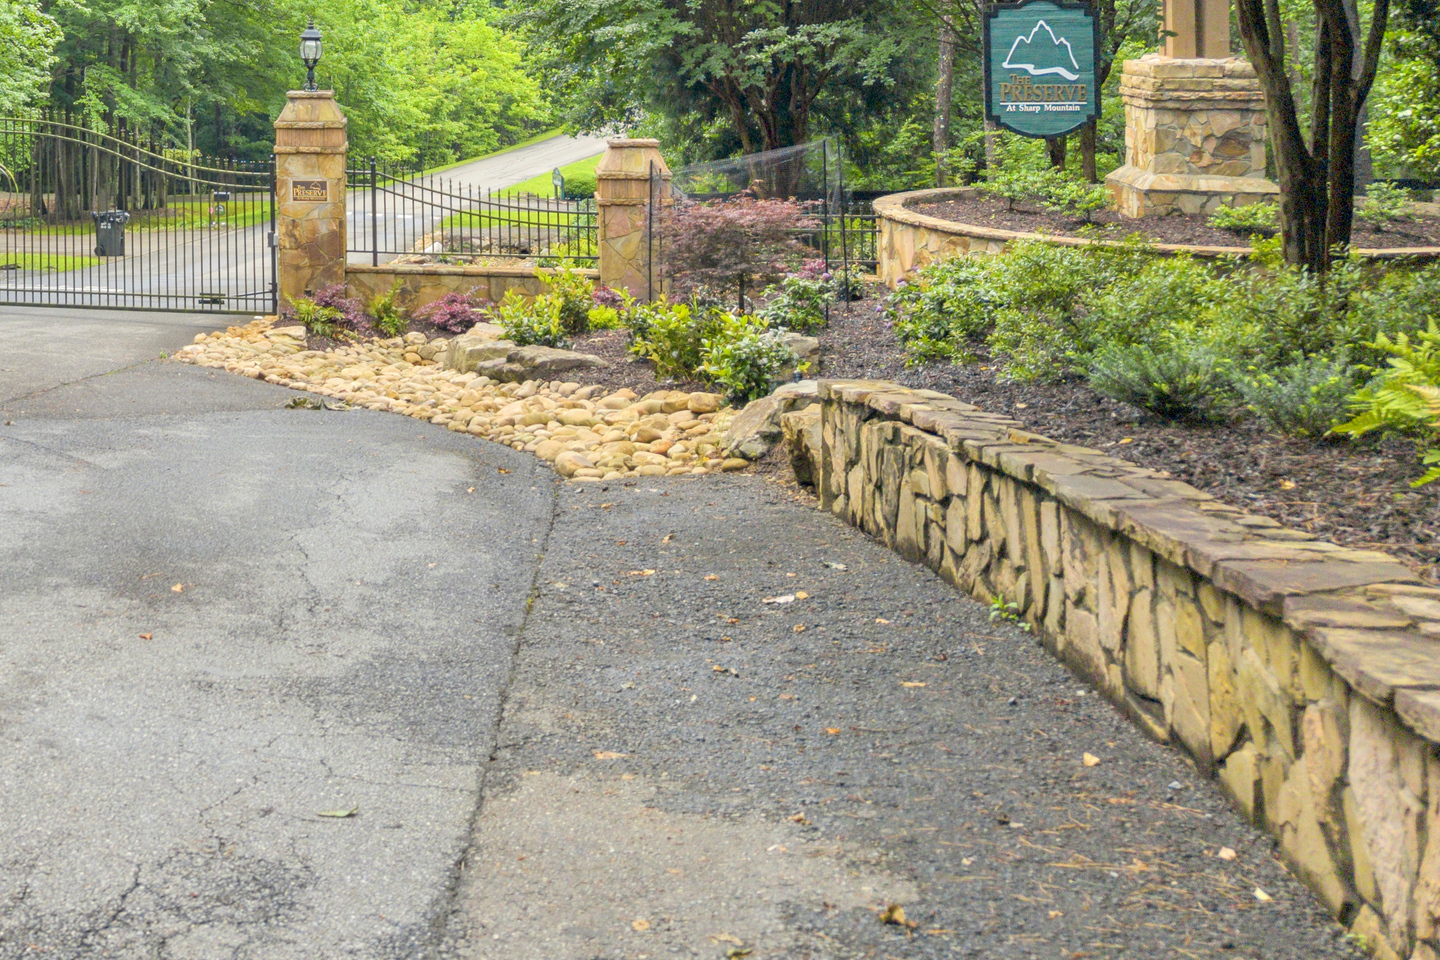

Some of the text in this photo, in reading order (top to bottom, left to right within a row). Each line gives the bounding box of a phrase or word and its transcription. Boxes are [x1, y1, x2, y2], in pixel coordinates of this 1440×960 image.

[1009, 73, 1031, 85] THE
[999, 82, 1088, 102] PRESERVE
[1006, 103, 1080, 113] At Sharp Mountain
[293, 187, 327, 196] PRESERVE
